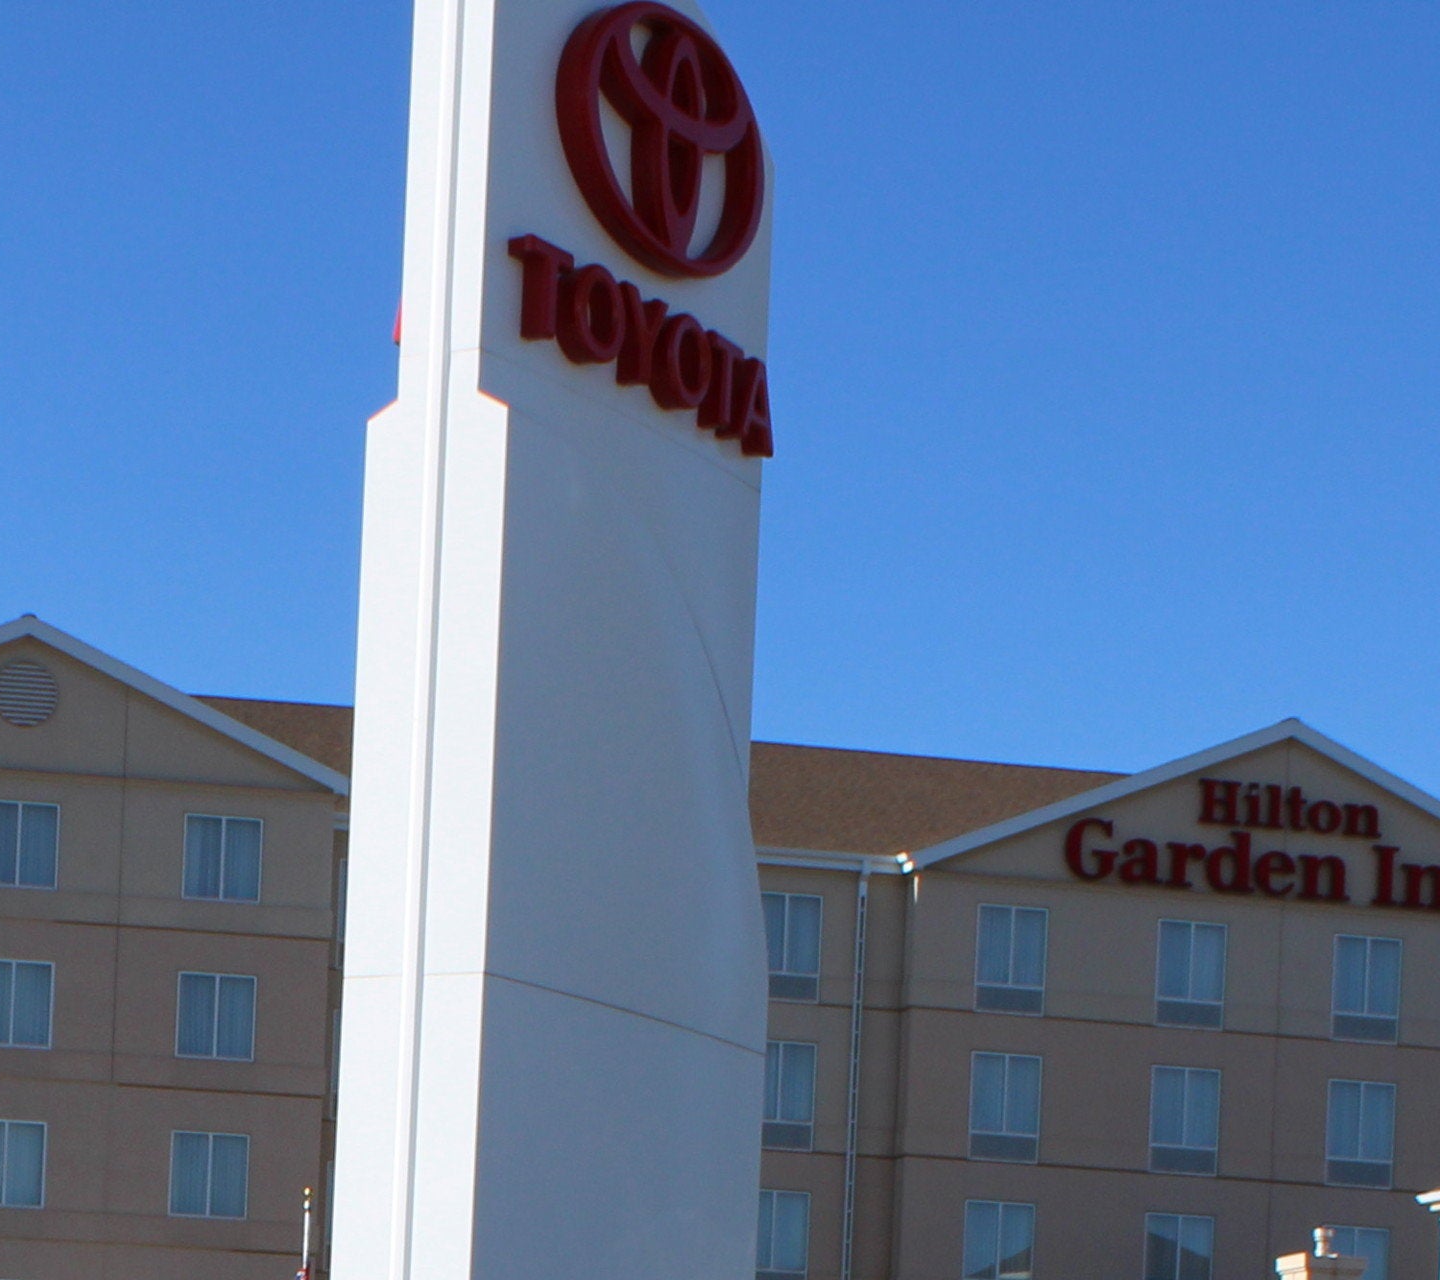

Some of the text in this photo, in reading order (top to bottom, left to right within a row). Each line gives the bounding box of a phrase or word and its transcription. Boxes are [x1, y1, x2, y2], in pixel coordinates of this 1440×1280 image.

[508, 234, 773, 457] TOYOTA
[1197, 778, 1381, 838] Hilton
[1064, 817, 1351, 901] Garden
